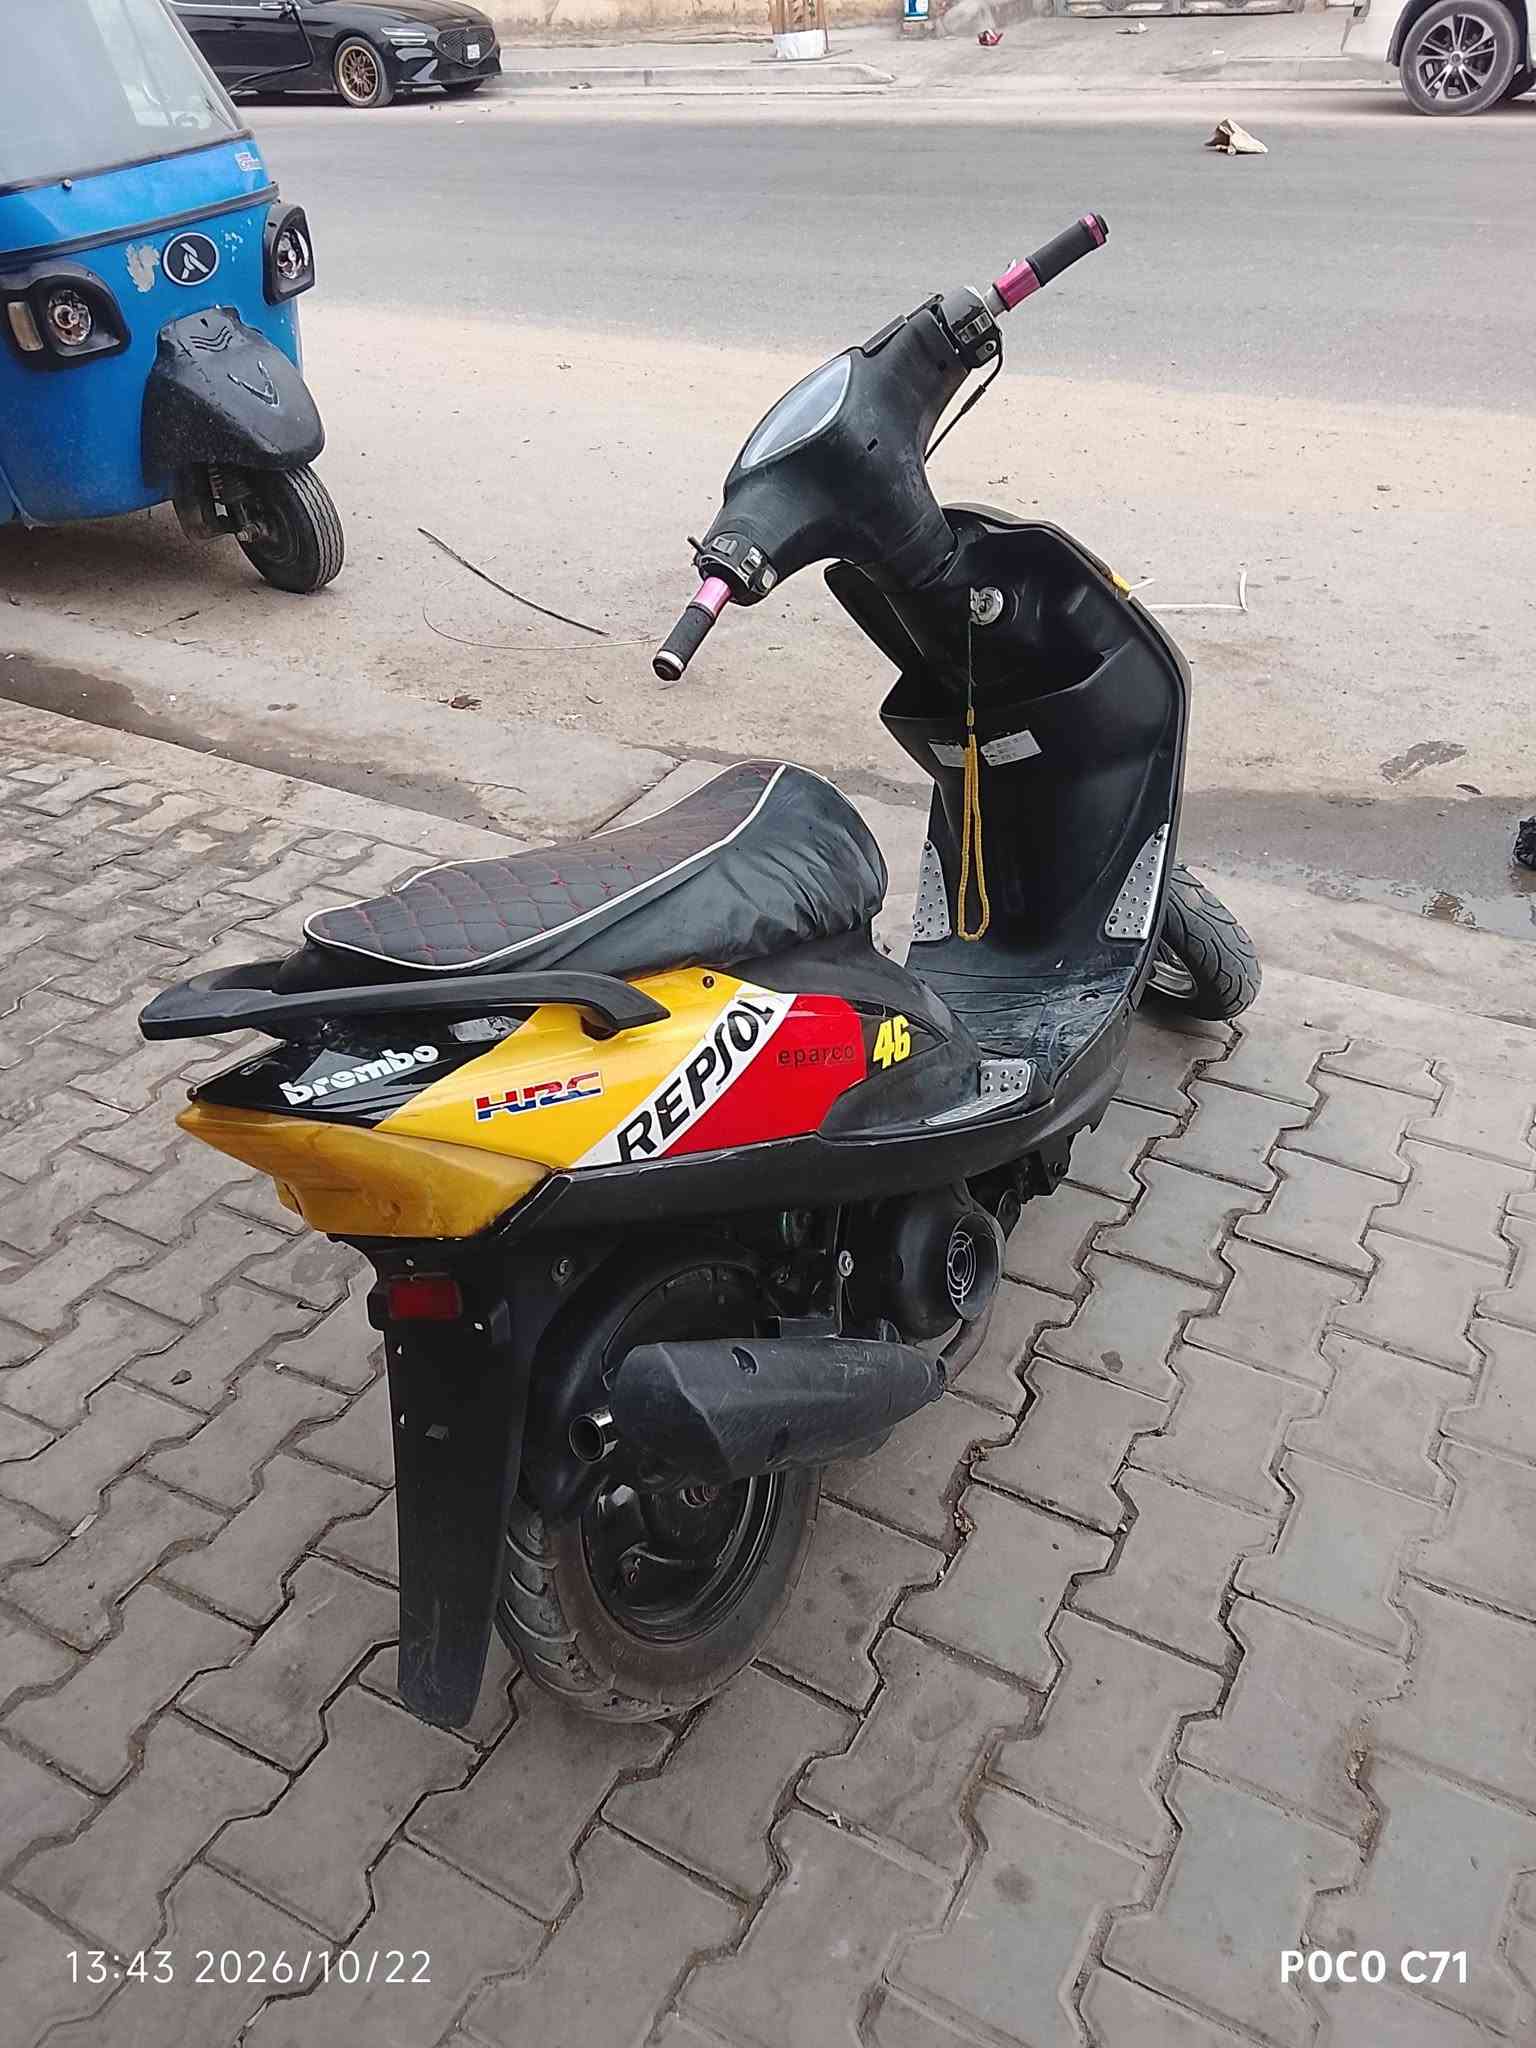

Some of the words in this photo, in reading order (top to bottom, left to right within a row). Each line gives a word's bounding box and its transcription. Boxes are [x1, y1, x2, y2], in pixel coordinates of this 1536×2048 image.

[872, 1014, 912, 1070] 46
[278, 1045, 439, 1106] brembo
[475, 1071, 602, 1121] HRC
[616, 999, 776, 1163] REPSOL
